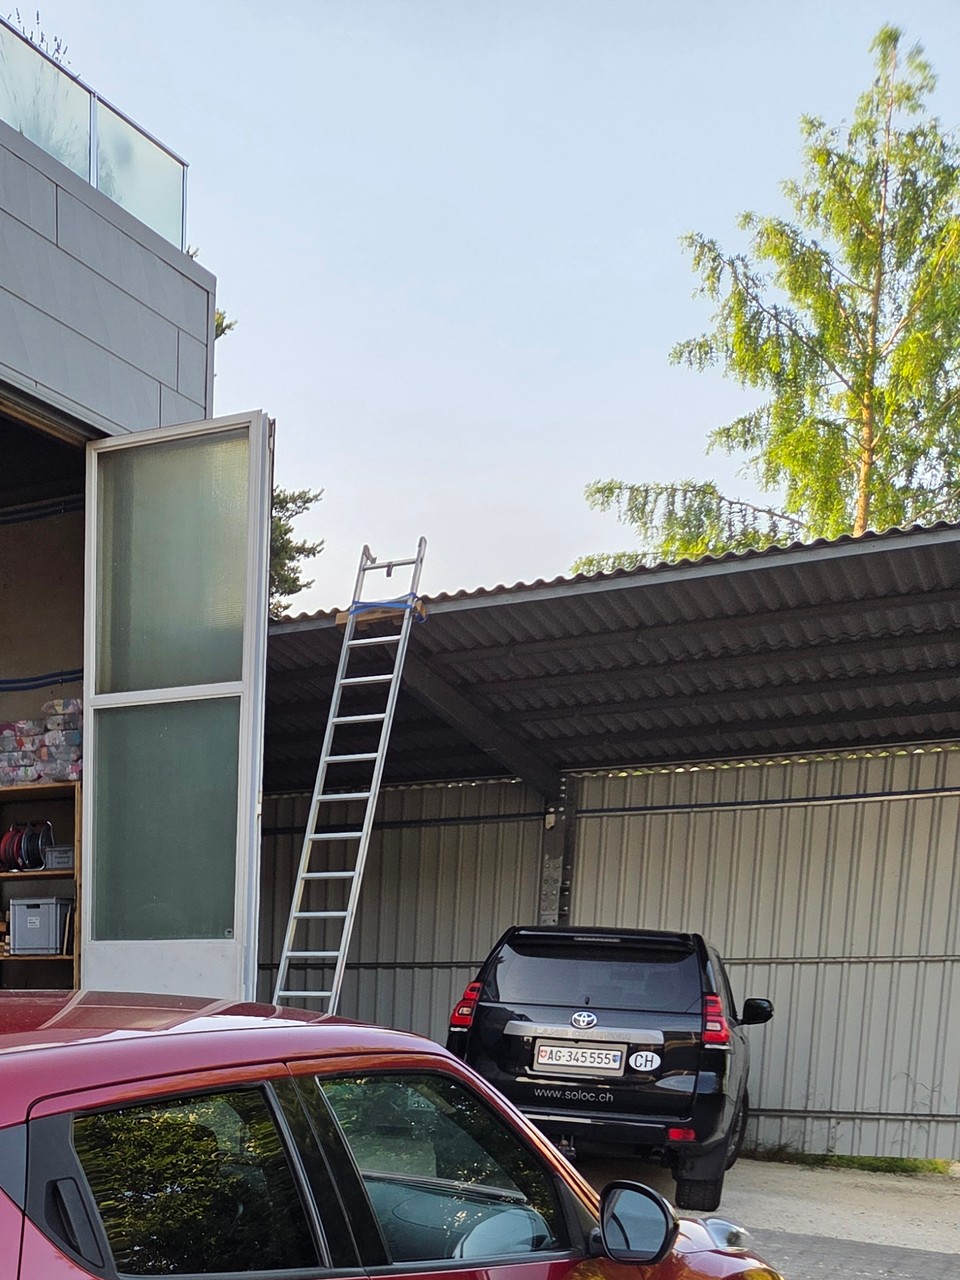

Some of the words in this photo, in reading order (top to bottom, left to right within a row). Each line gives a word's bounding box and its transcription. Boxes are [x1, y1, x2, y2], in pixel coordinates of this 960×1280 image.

[533, 1027, 569, 1037] LAND
[634, 1053, 654, 1068] CH
[534, 1088, 614, 1102] www.soloc.ch
